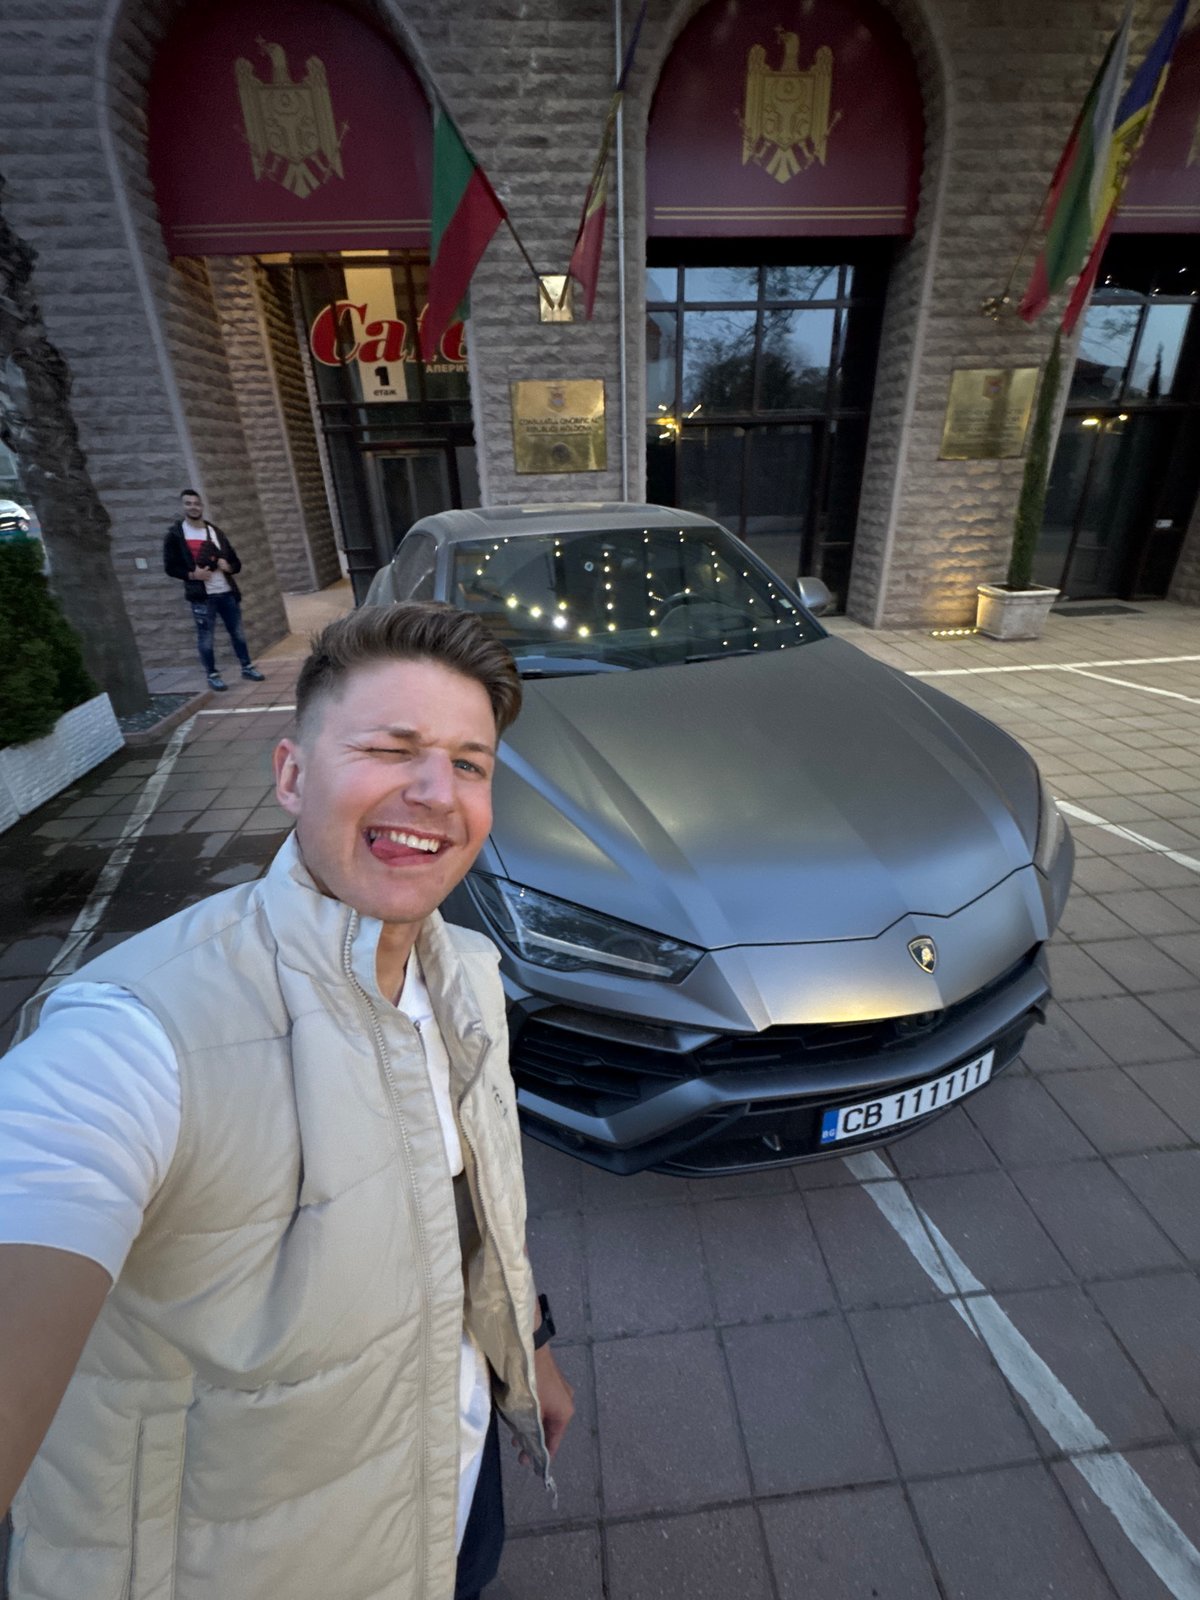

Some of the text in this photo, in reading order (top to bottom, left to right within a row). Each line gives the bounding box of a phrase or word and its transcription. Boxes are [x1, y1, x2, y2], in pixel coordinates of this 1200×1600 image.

[374, 366, 390, 386] 1
[842, 1103, 882, 1133] CB
[895, 1060, 984, 1120] 111111
[821, 1128, 836, 1138] BG
